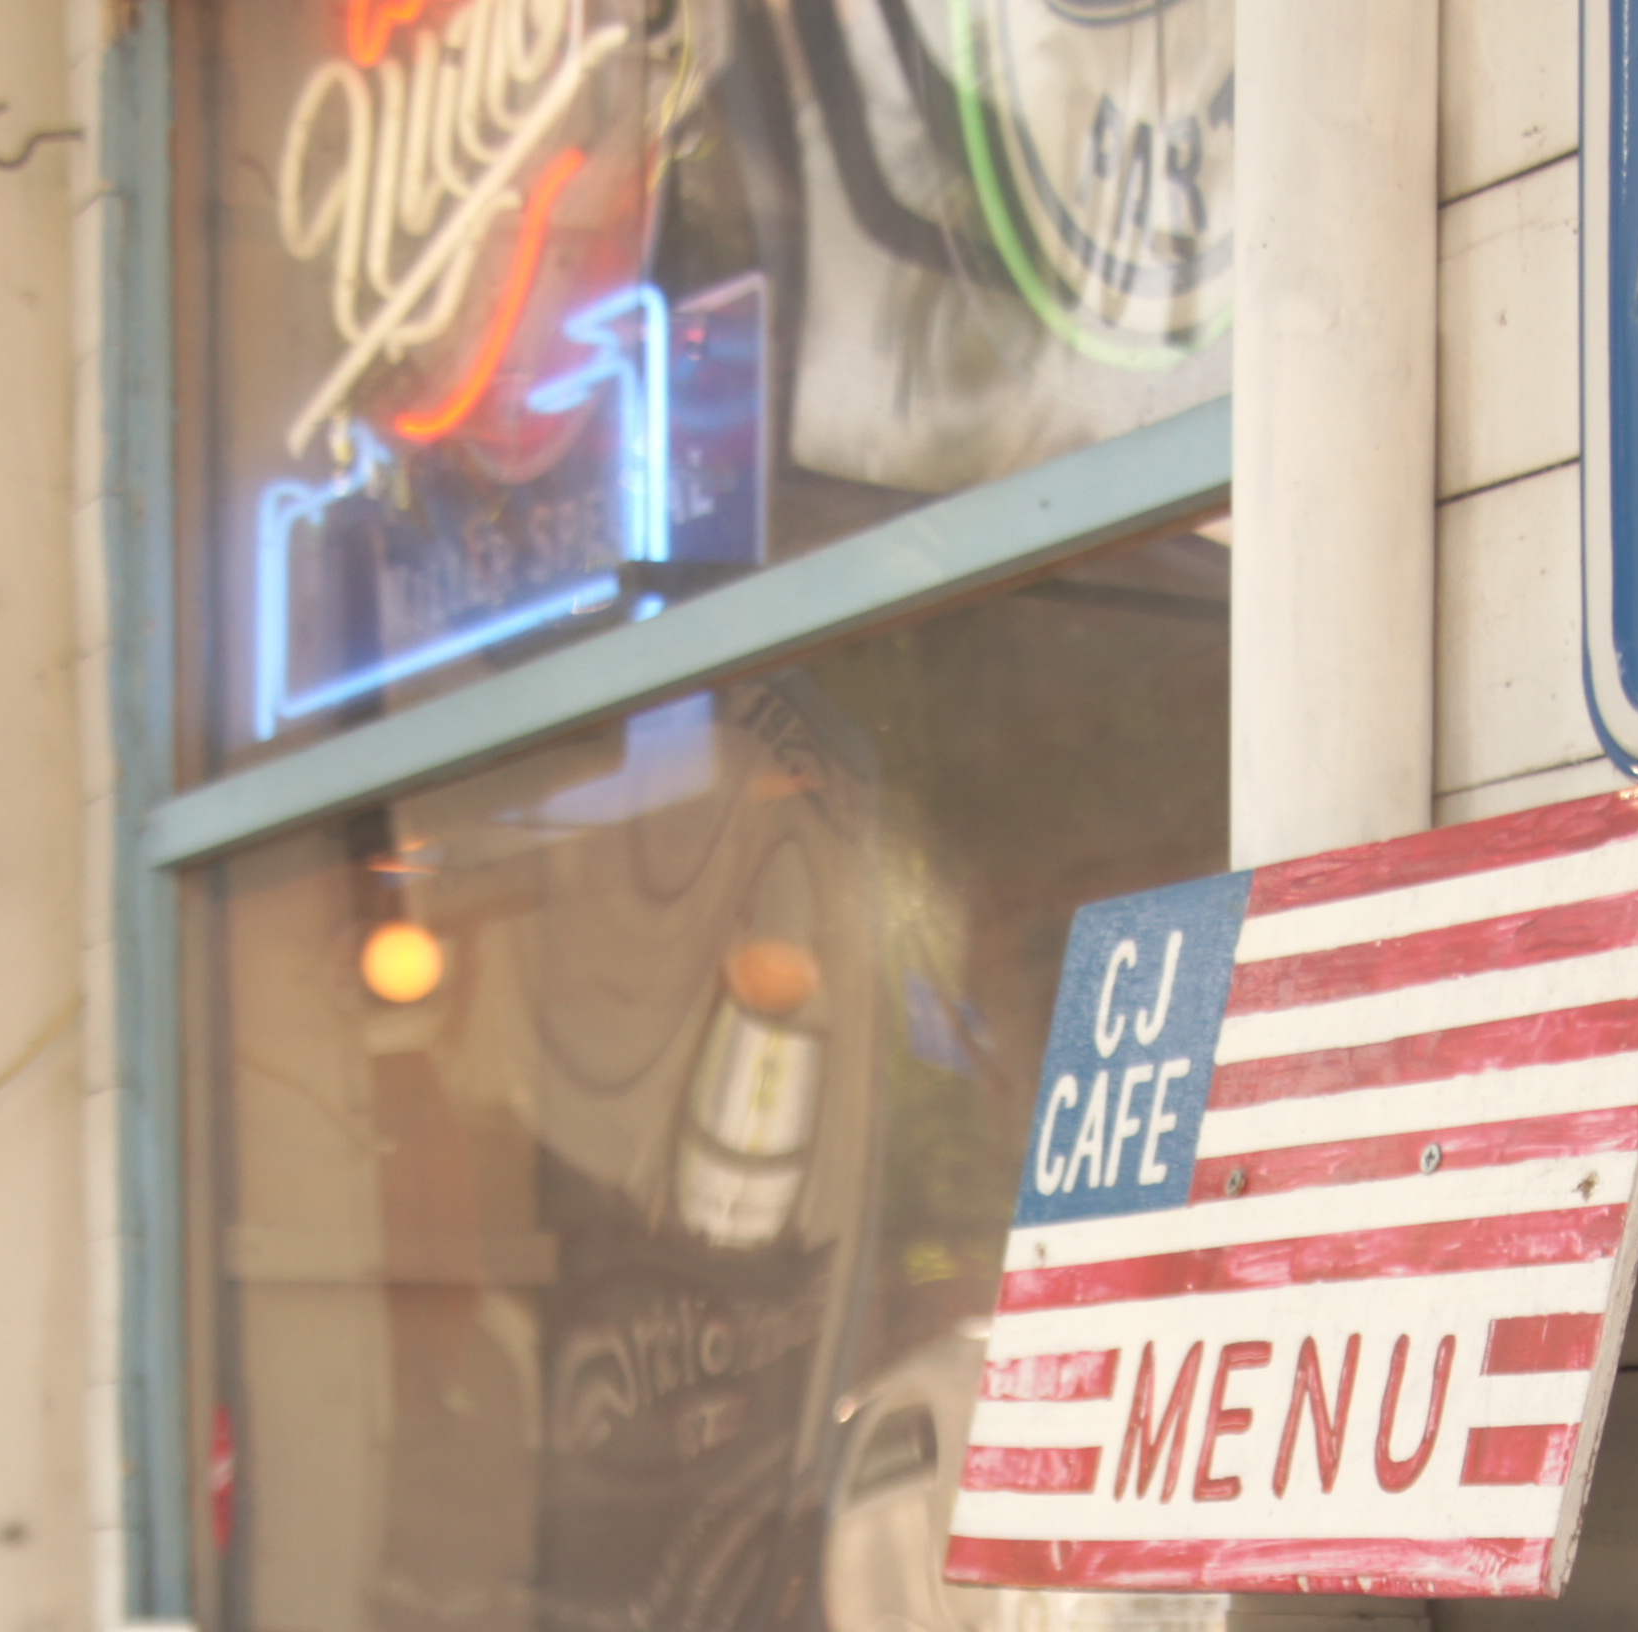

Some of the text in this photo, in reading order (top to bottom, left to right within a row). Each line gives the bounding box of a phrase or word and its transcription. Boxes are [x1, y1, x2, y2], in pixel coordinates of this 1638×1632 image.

[1093, 930, 1184, 1059] CJ
[1035, 1057, 1190, 1197] CAFE
[1113, 1333, 1457, 1504] MENU
